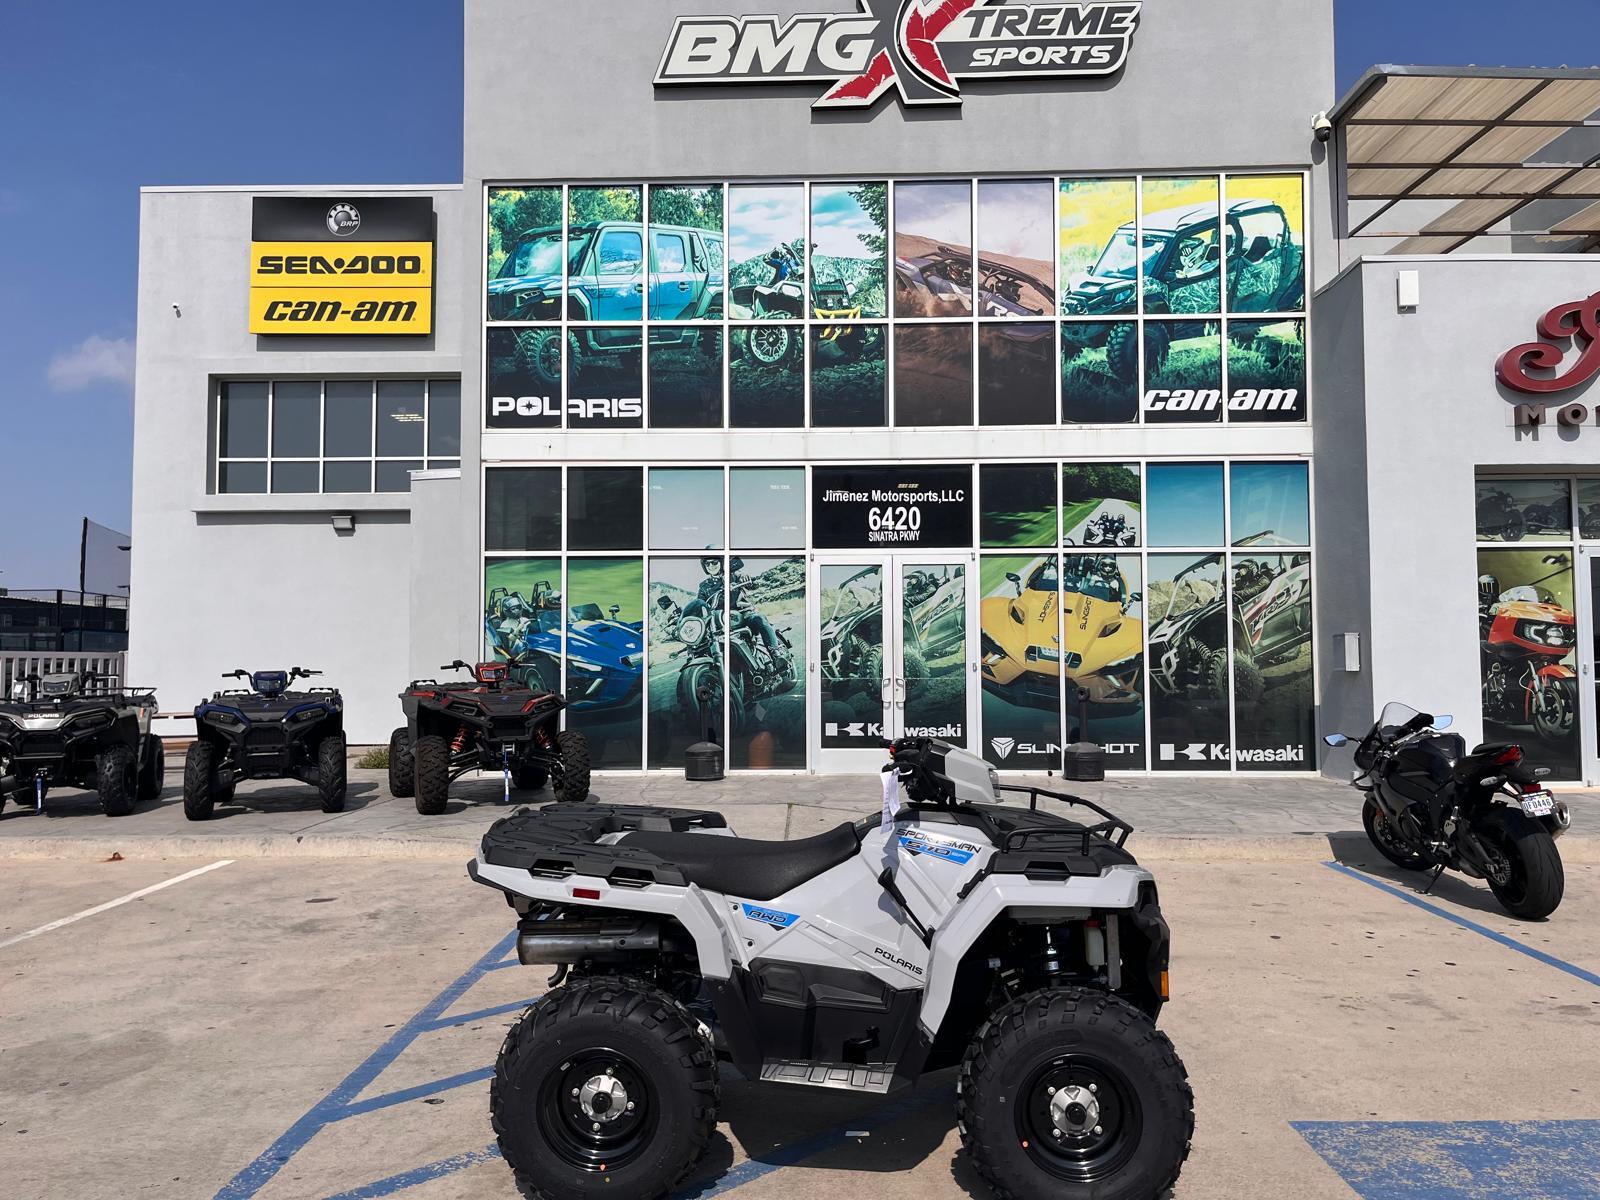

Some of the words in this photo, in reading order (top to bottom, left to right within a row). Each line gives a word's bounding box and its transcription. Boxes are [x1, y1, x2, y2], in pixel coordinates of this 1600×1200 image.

[667, 20, 881, 74] BMG
[968, 44, 1115, 67] SPORTS
[264, 301, 417, 321] can-am
[492, 396, 642, 418] POLARIS
[1514, 403, 1600, 426] MO
[869, 506, 921, 530] 6420
[869, 531, 899, 542] SINATRA
[900, 531, 920, 541] PKWY
[896, 828, 982, 853] SPORSMAN
[749, 910, 787, 923] AWD
[874, 947, 923, 975] POLARIS
